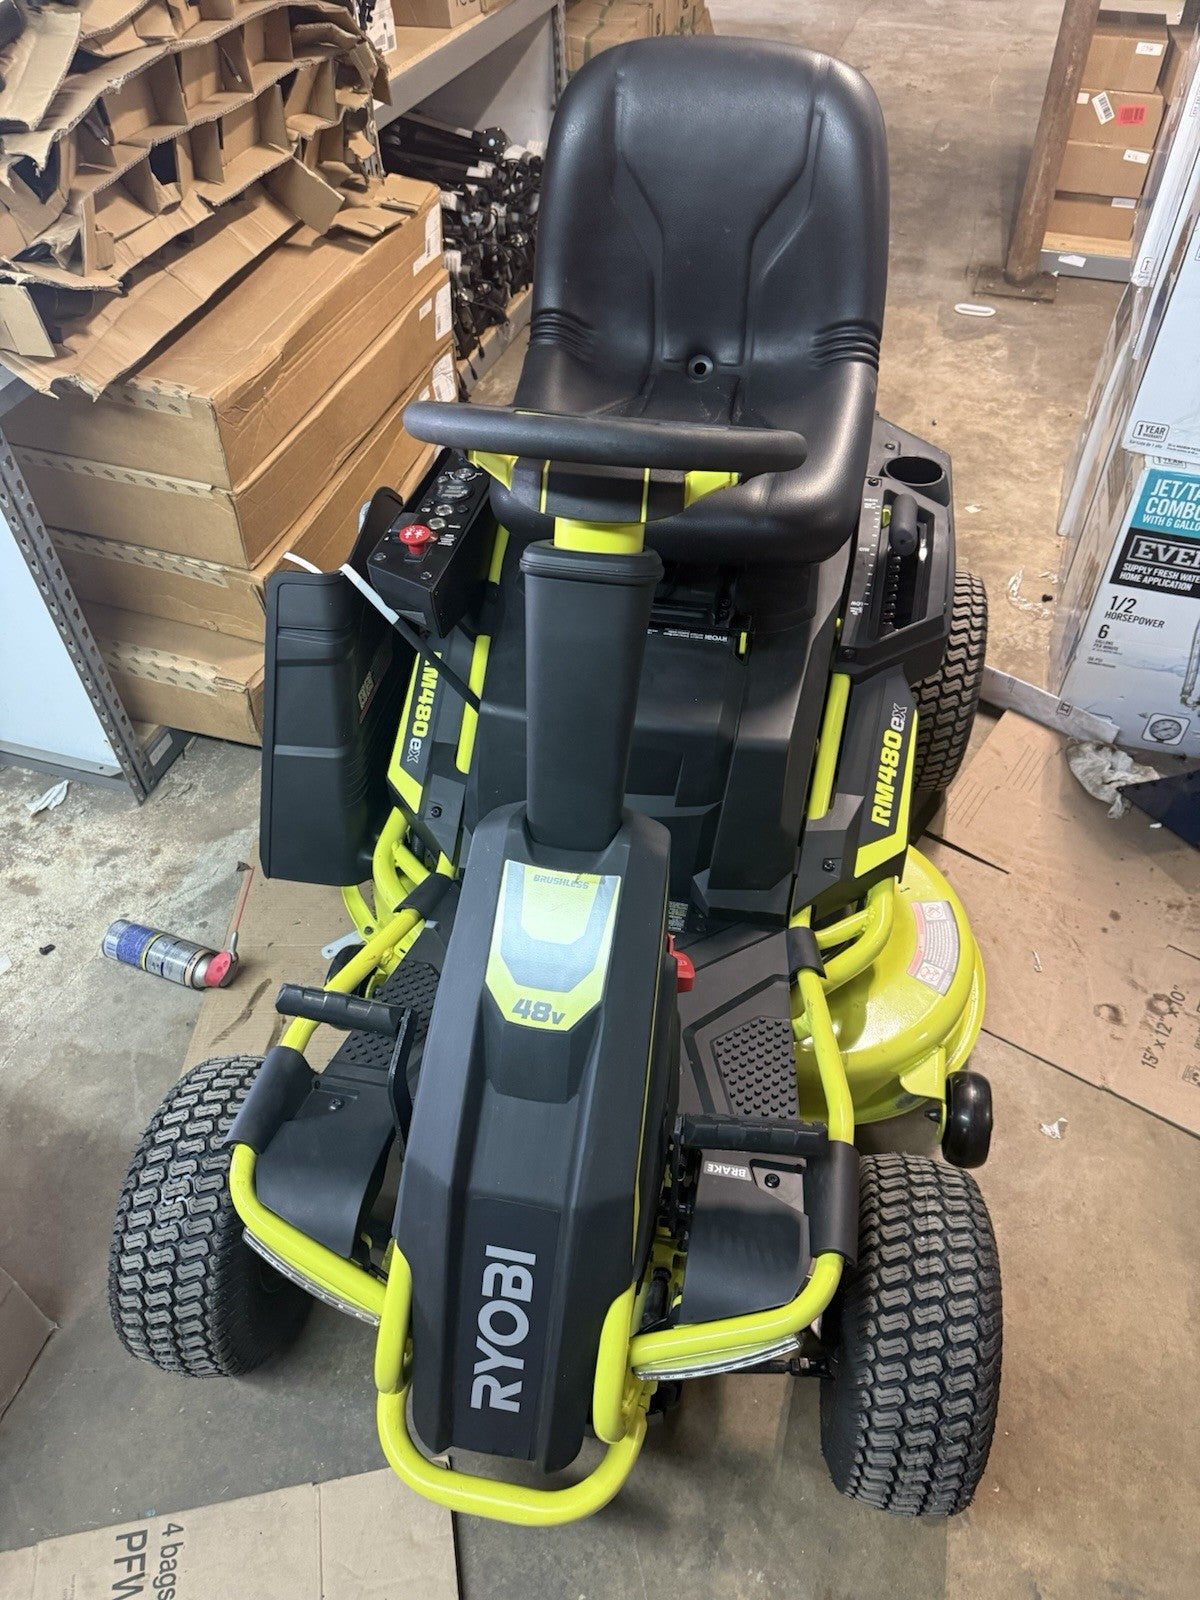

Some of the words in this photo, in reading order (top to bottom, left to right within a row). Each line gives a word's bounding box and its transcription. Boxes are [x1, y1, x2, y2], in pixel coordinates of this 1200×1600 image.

[1138, 424, 1144, 436] 1
[1145, 424, 1166, 436] YEAR
[1142, 514, 1166, 526] WITH
[1165, 519, 1173, 527] 6
[1122, 563, 1152, 575] SUPPLY
[1152, 567, 1180, 580] FRESH
[1119, 571, 1142, 583] HOME
[1142, 576, 1193, 591] APPLICATION
[1110, 595, 1137, 613] 1/2
[1104, 611, 1165, 628] HORSEPOWER
[1097, 624, 1110, 639] 6
[533, 874, 590, 890] BRUSHLESS
[1154, 1015, 1172, 1038] 12"
[1153, 1039, 1166, 1049] x
[1141, 1046, 1159, 1069] 15"
[707, 1163, 746, 1178] BRAKE
[470, 1245, 537, 1413] RYOBI
[162, 1523, 184, 1537] 4
[152, 1542, 184, 1600] bags
